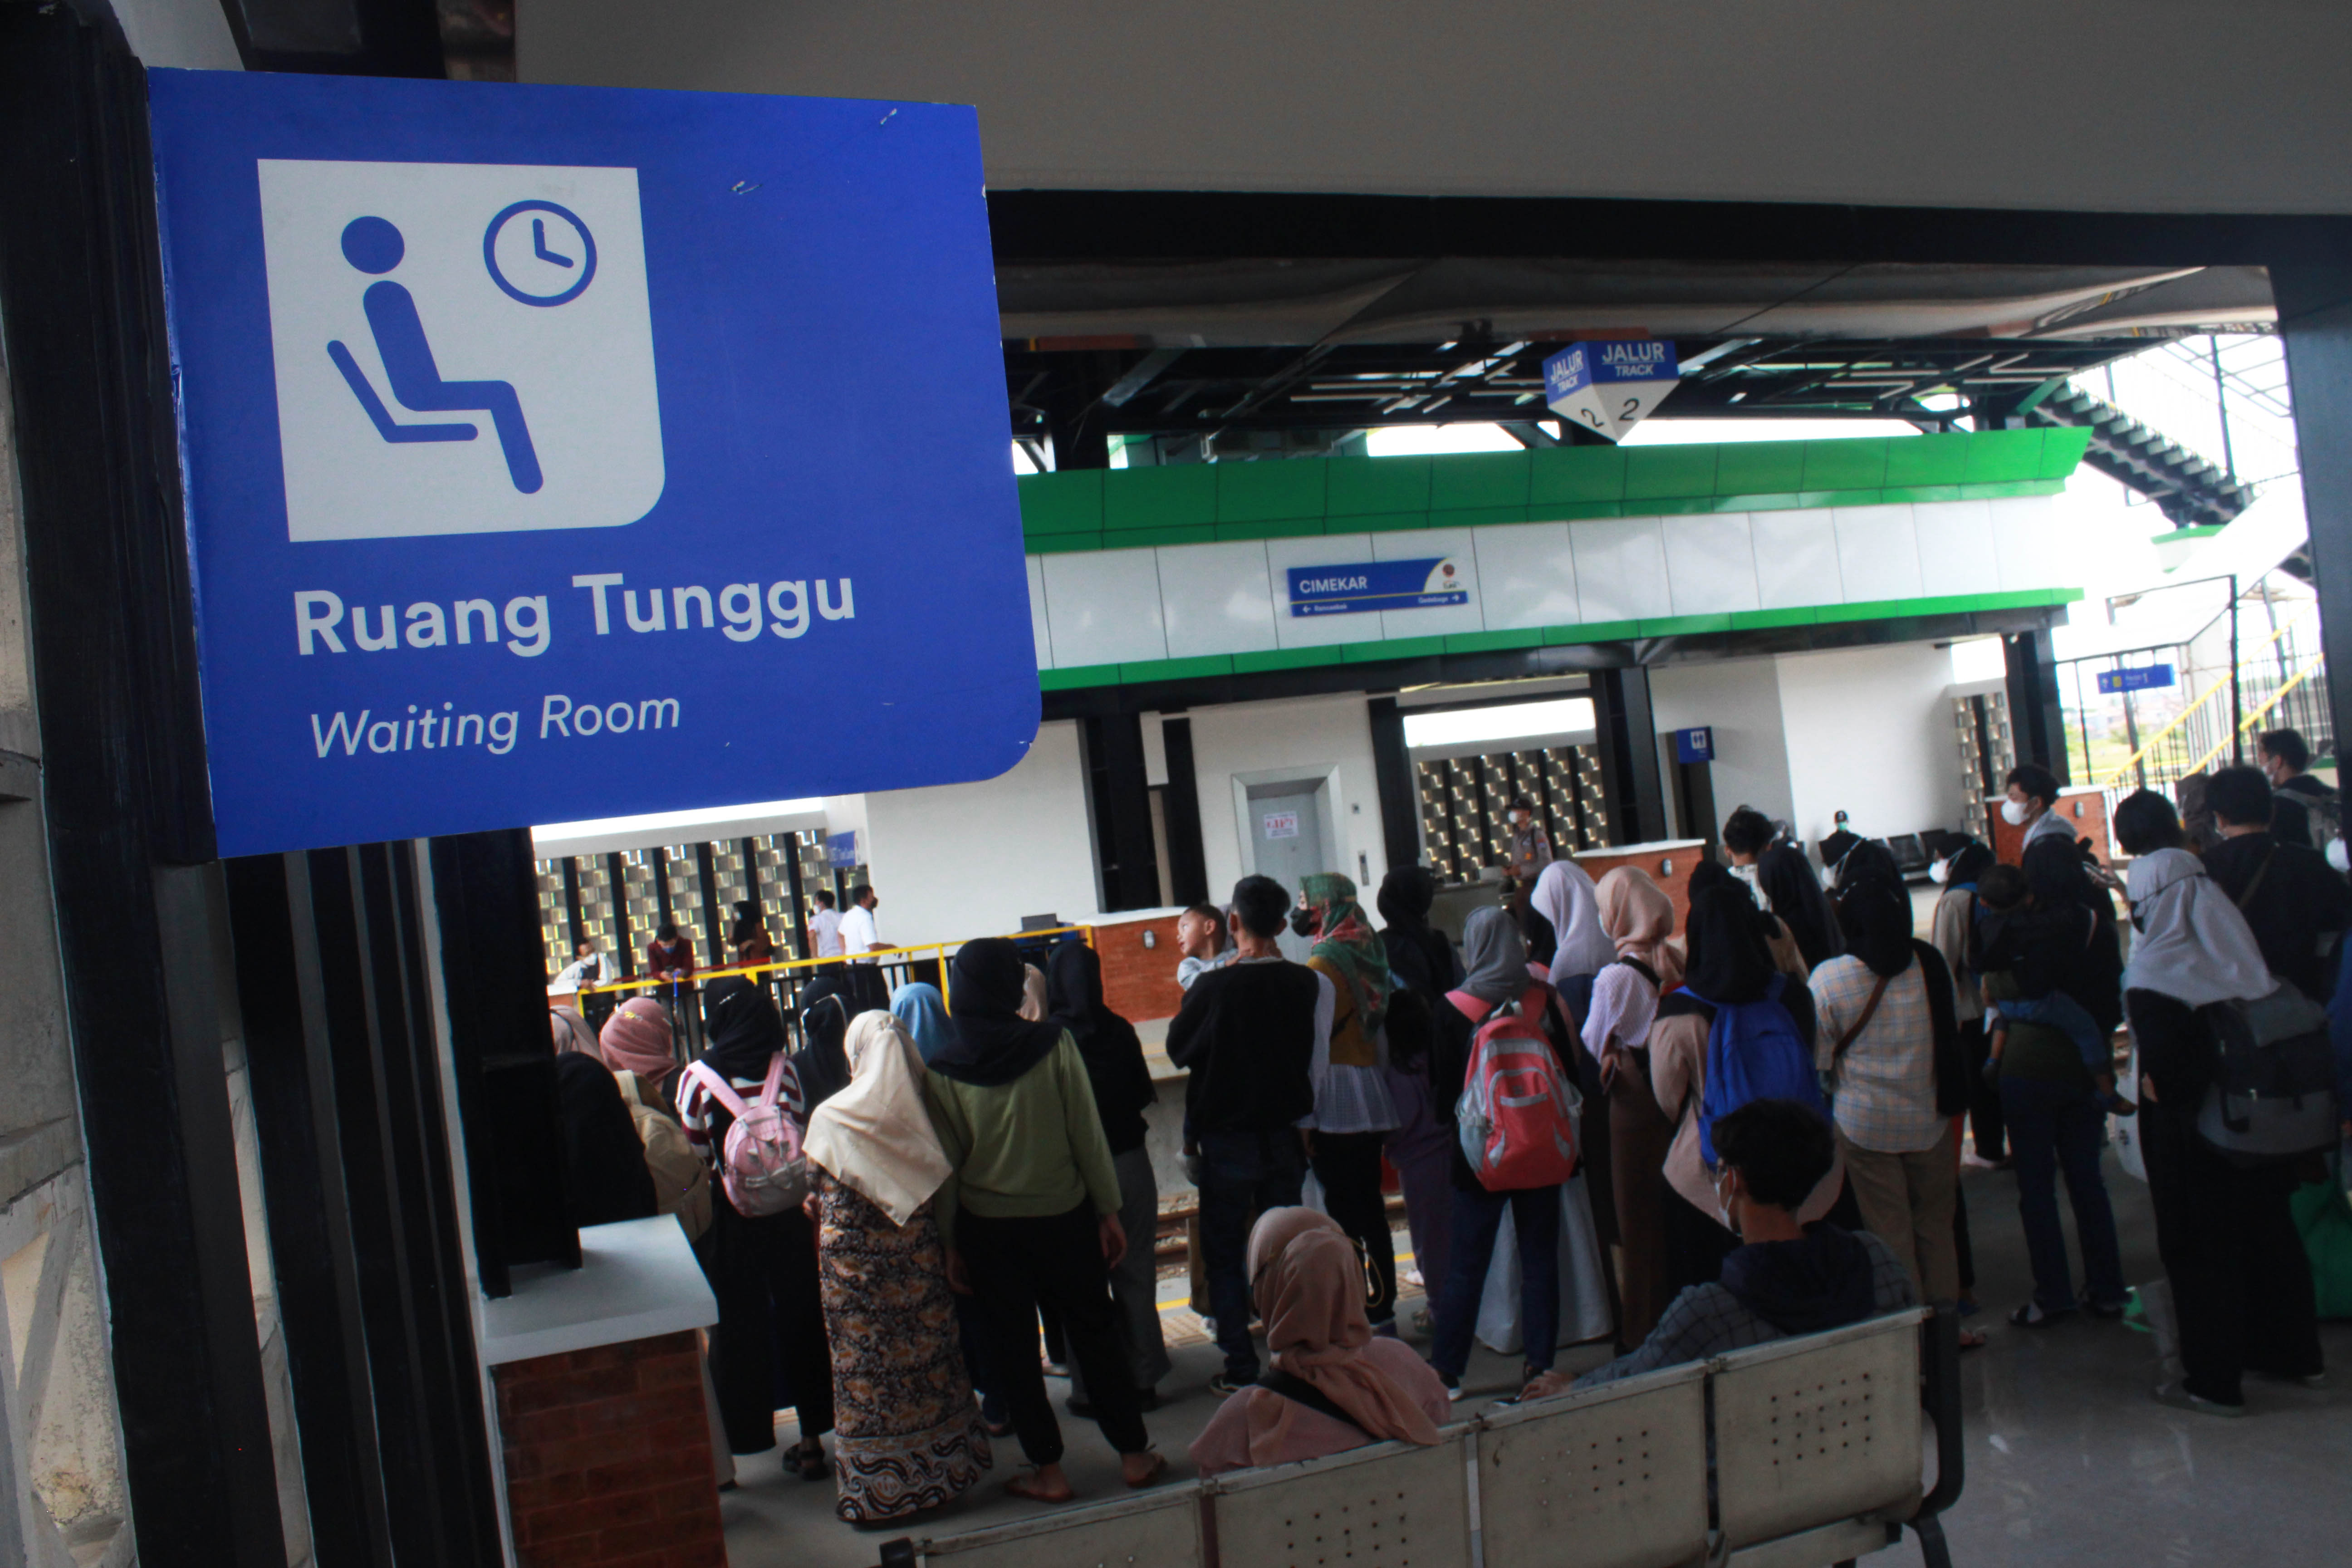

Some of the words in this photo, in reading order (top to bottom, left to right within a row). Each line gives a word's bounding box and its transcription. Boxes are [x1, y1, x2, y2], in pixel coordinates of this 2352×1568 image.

[1602, 343, 1664, 362] JALUR
[1551, 350, 1583, 380] JALUR
[1615, 364, 1653, 377] TRACK
[1558, 375, 1578, 393] TRACK
[1618, 397, 1640, 421] 2
[1299, 576, 1367, 593] CIMEKAR
[294, 589, 550, 657] Ruang
[571, 572, 855, 642] Tunggu
[311, 701, 518, 758] Waiting
[539, 694, 680, 739] Room
